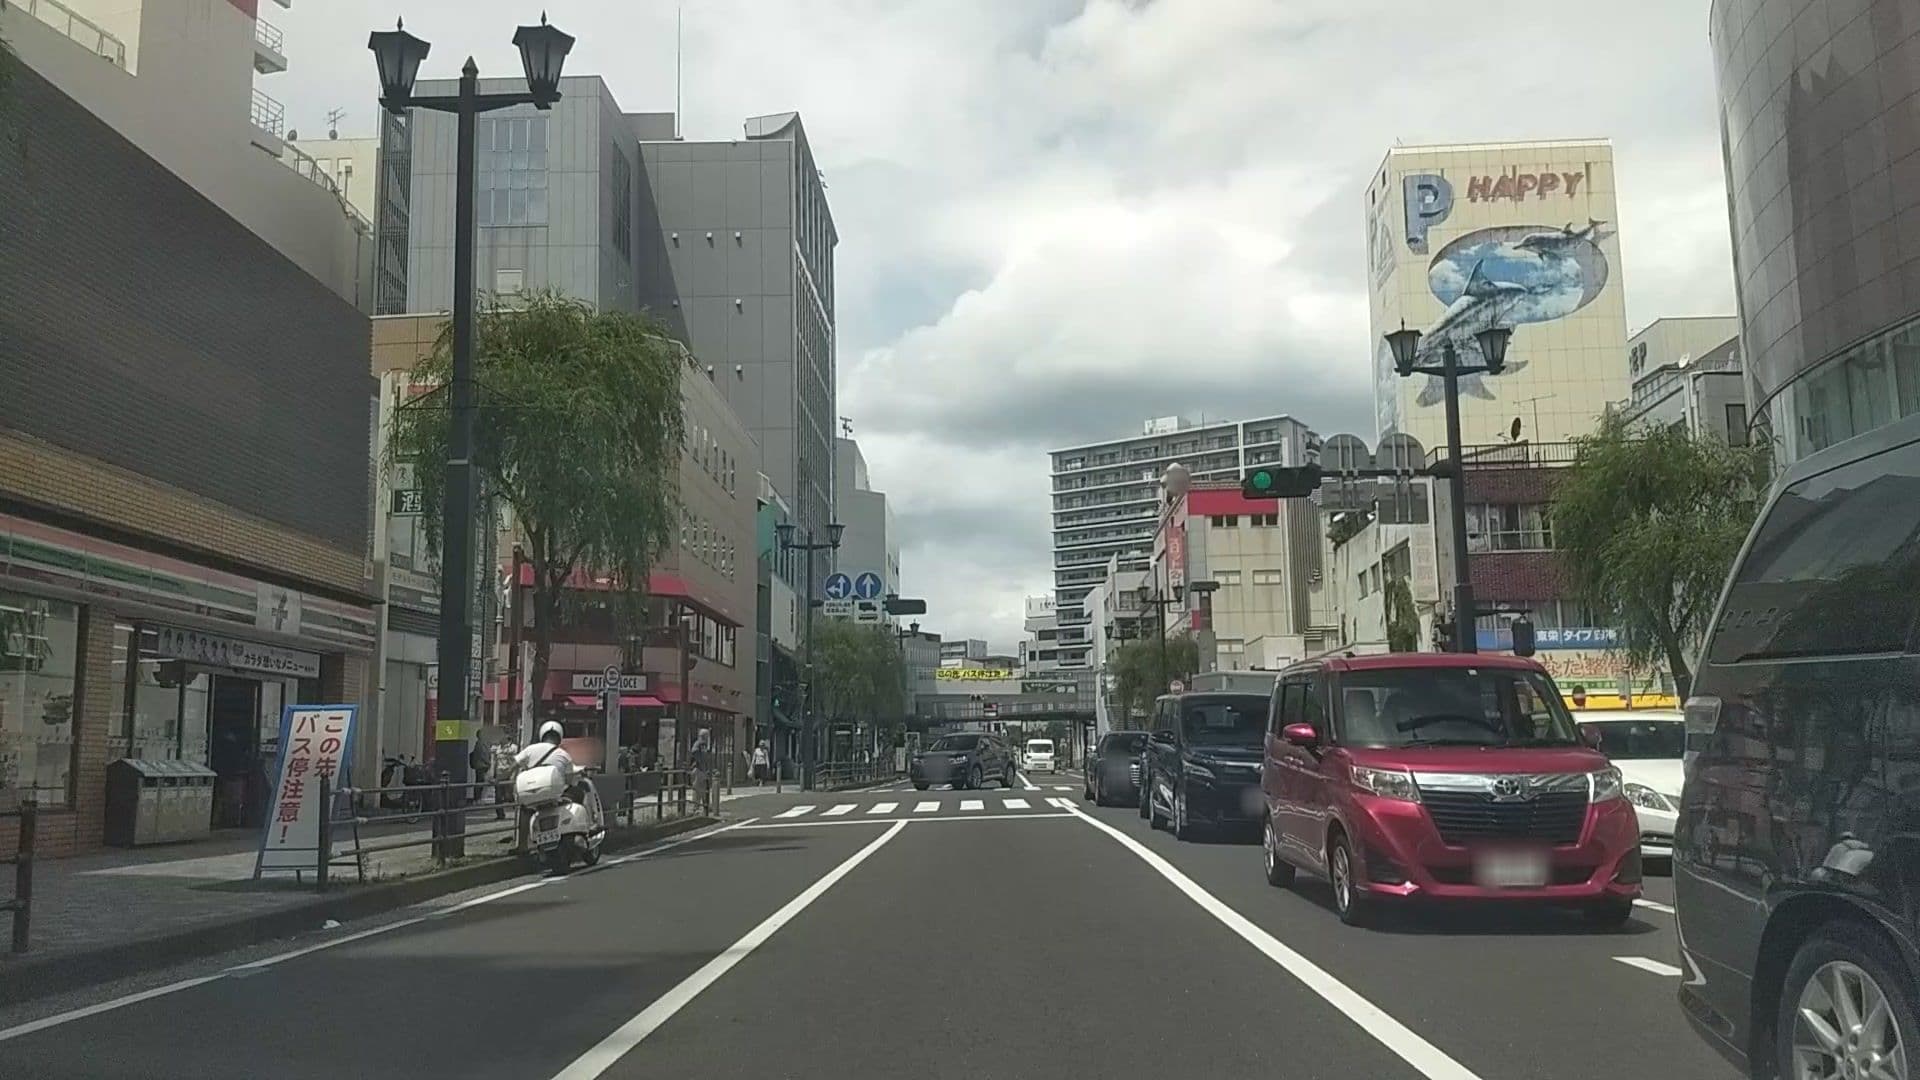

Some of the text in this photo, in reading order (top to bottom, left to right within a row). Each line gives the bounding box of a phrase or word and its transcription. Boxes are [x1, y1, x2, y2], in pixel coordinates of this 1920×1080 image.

[1563, 629, 1592, 641] タイプ
[314, 715, 344, 778] この先
